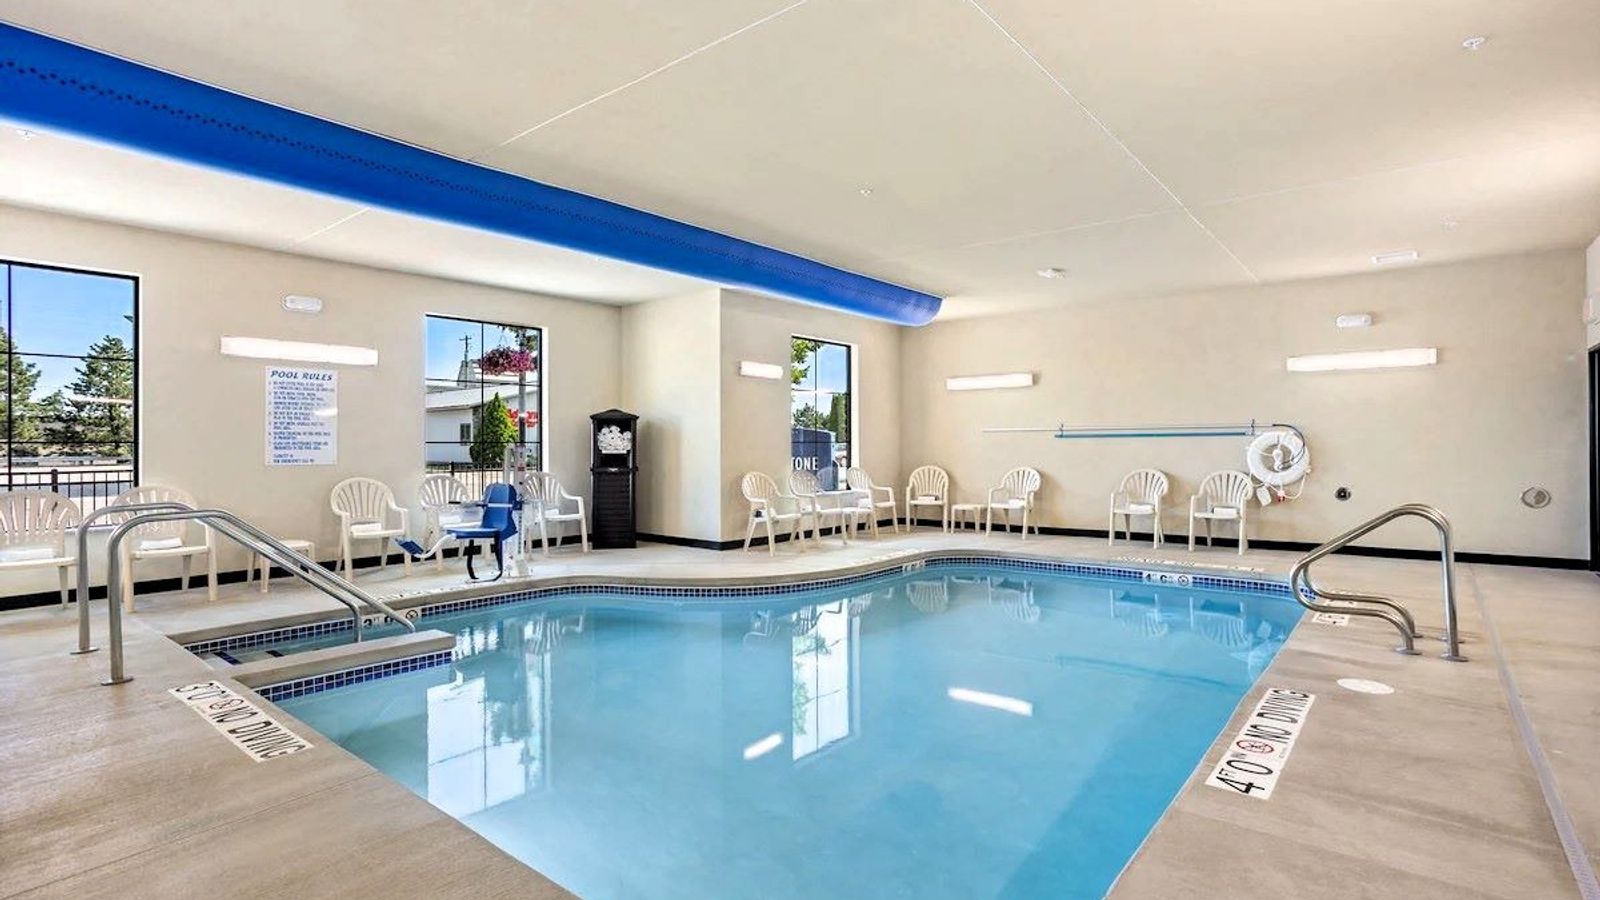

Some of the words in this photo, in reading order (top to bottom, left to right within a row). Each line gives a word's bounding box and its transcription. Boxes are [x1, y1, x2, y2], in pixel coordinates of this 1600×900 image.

[270, 370, 299, 379] POOL
[302, 372, 333, 381] RULES
[208, 705, 258, 723] NO
[1256, 689, 1310, 724] DIVING
[226, 720, 307, 759] DIVING
[1243, 724, 1293, 744] NO
